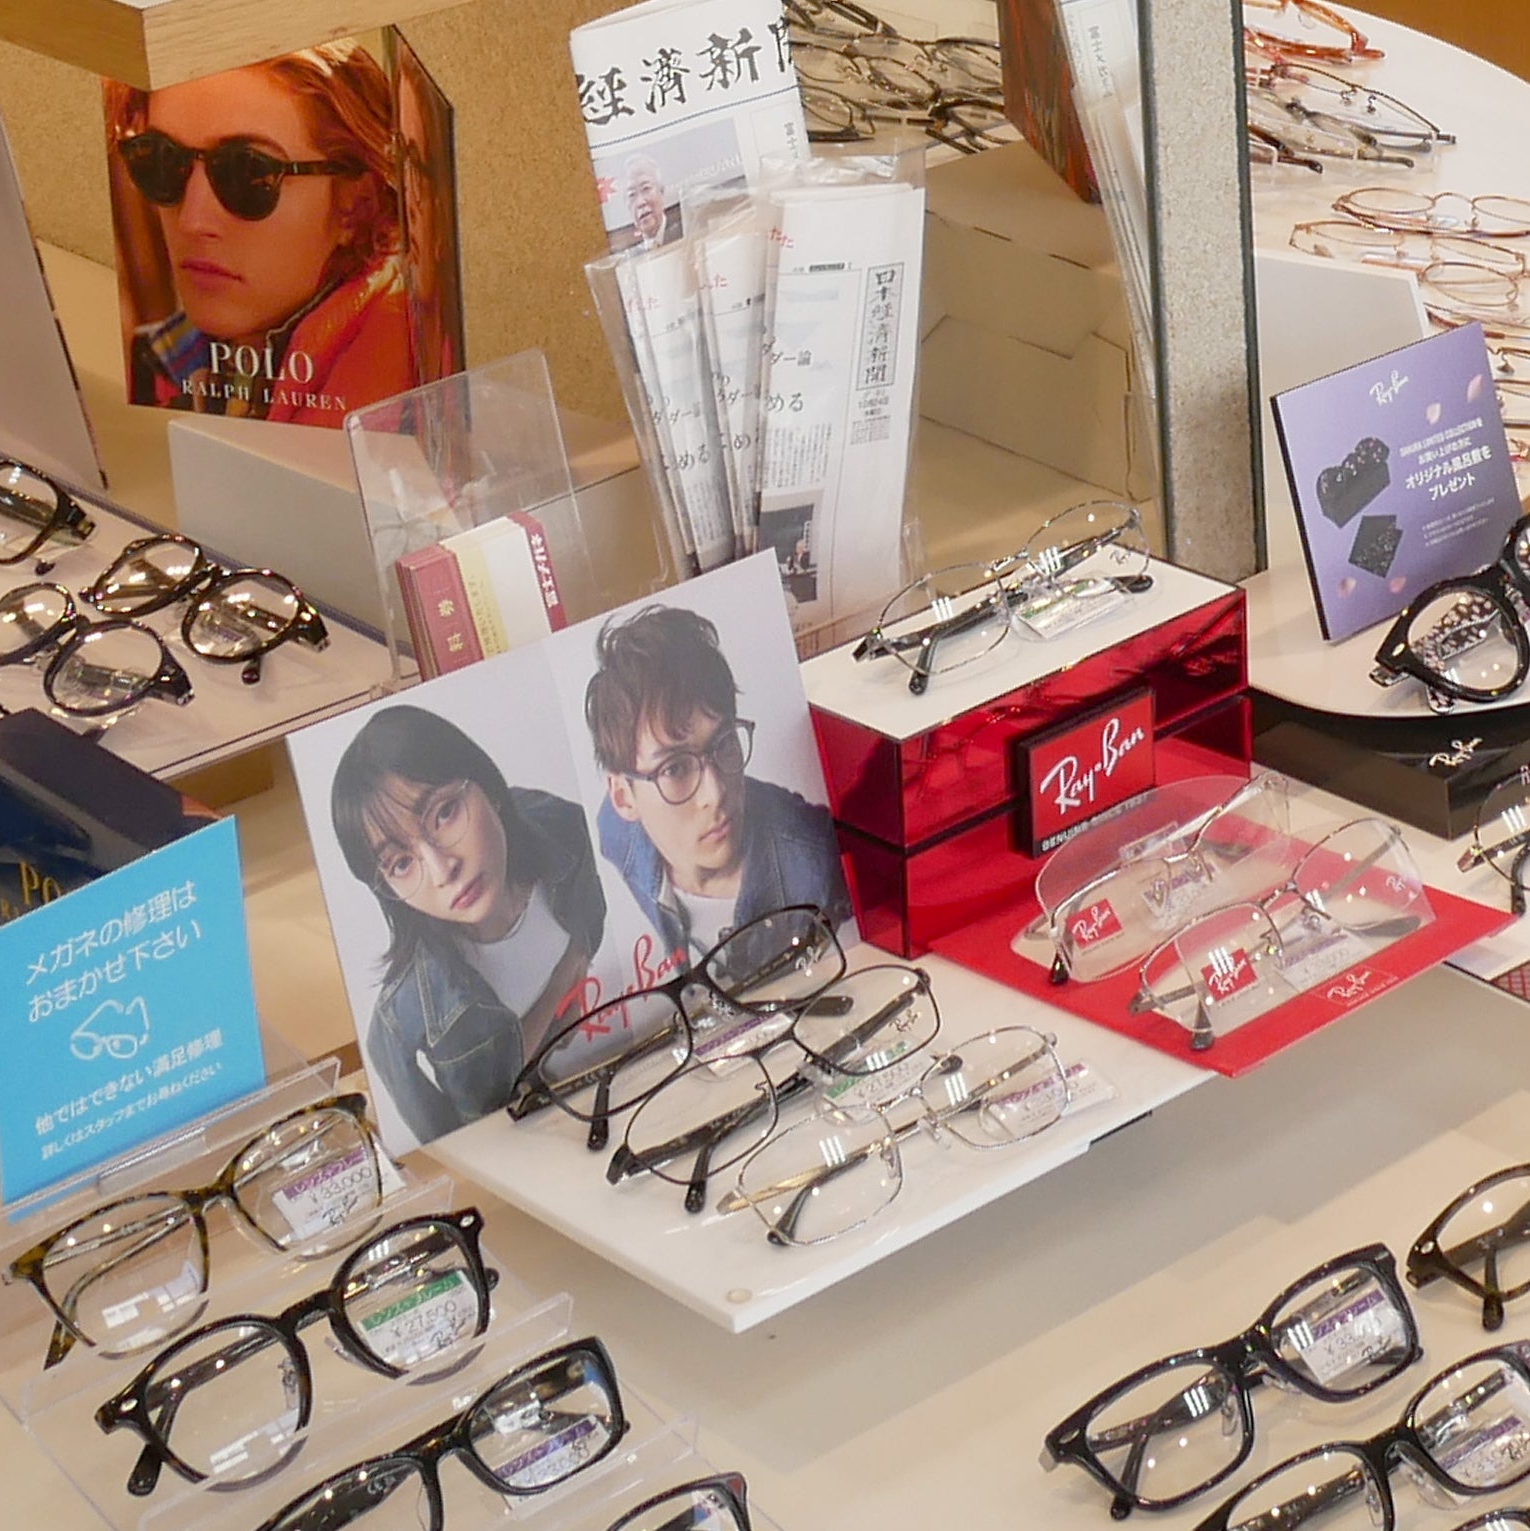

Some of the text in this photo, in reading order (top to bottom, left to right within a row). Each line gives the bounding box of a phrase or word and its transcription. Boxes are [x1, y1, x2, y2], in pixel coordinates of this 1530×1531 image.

[209, 341, 315, 384] POLO
[181, 379, 347, 411] RALPH LAUREN
[1429, 472, 1476, 501] プレゼント
[18, 860, 64, 907] PO
[25, 880, 198, 986] メガネの修理は
[28, 919, 202, 1023] おまかせ下さい
[34, 1027, 223, 1136] 他ではできない満足修理
